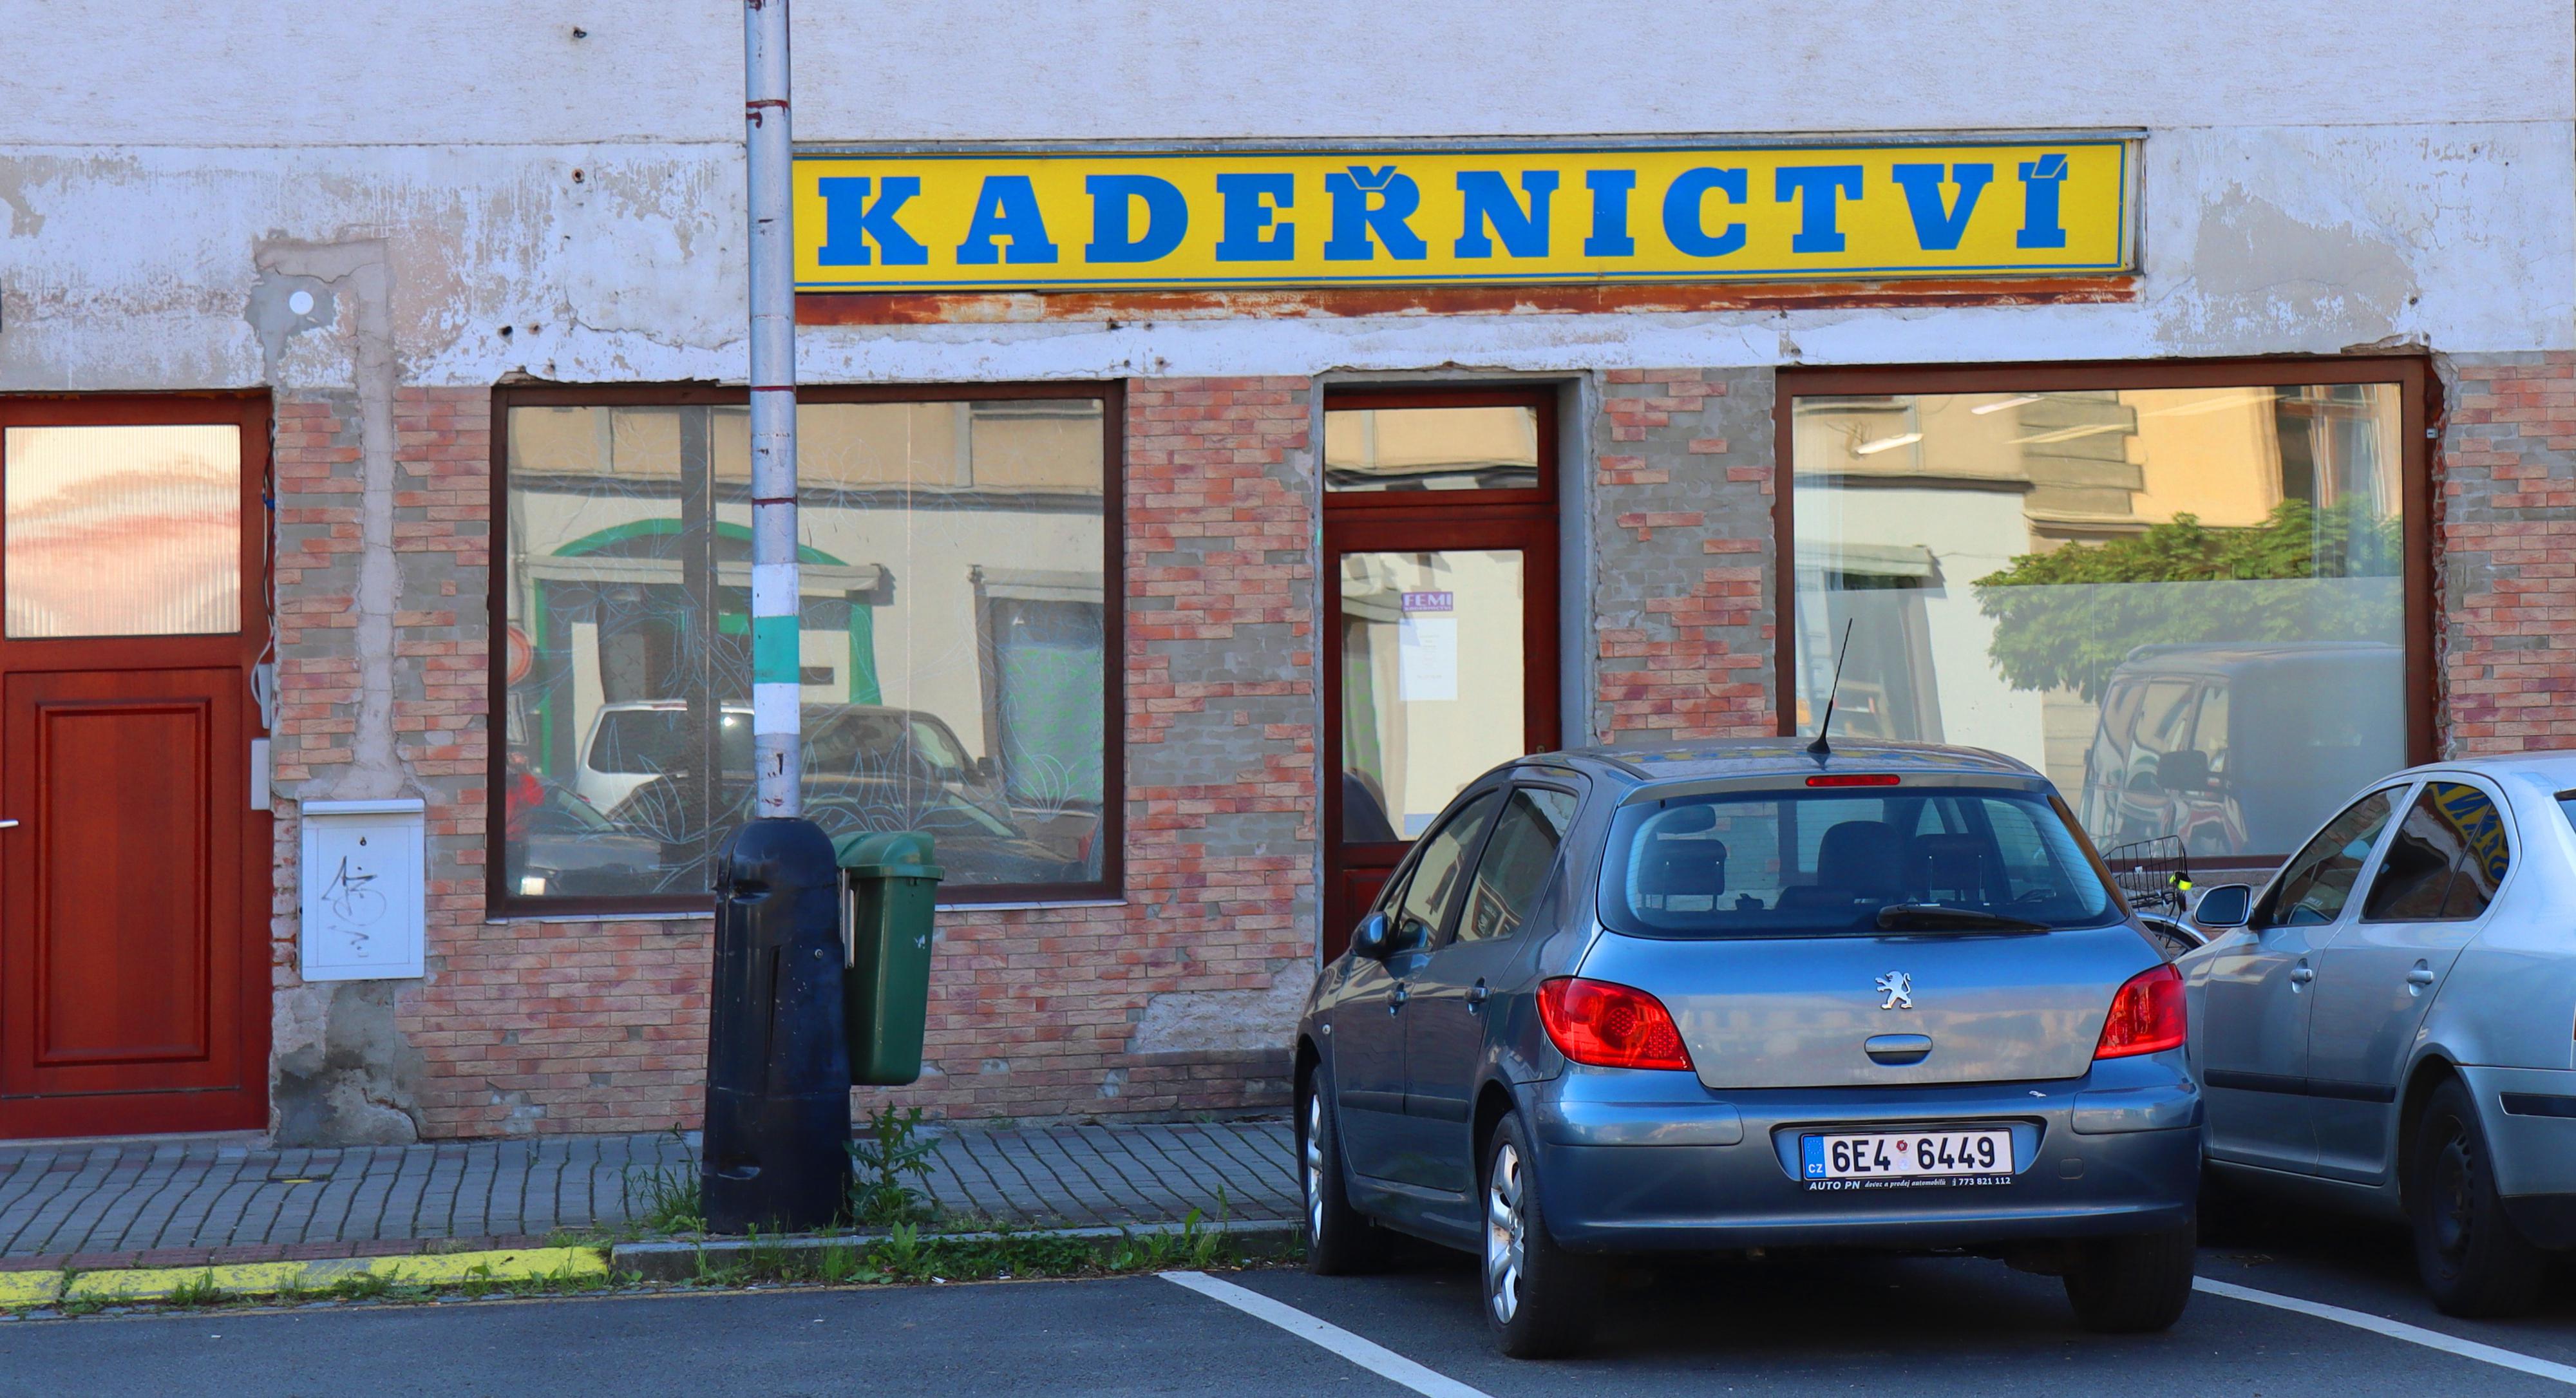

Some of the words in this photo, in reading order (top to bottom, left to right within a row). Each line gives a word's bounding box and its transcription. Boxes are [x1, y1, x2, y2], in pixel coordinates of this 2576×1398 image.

[818, 154, 2068, 266] KADEŘNICTVÍ
[1403, 593, 1452, 606] FEMI
[1832, 1139, 1891, 1172] 6E4
[1917, 1137, 1995, 1169] 6449
[1808, 1163, 1823, 1173] CZ
[1809, 1181, 1841, 1191] AUTO
[1844, 1180, 1861, 1190] PN
[1889, 1179, 1910, 1188] prodej
[1958, 1178, 1975, 1186] 773
[1977, 1177, 1992, 1185] 821
[1995, 1176, 2011, 1185] 112
